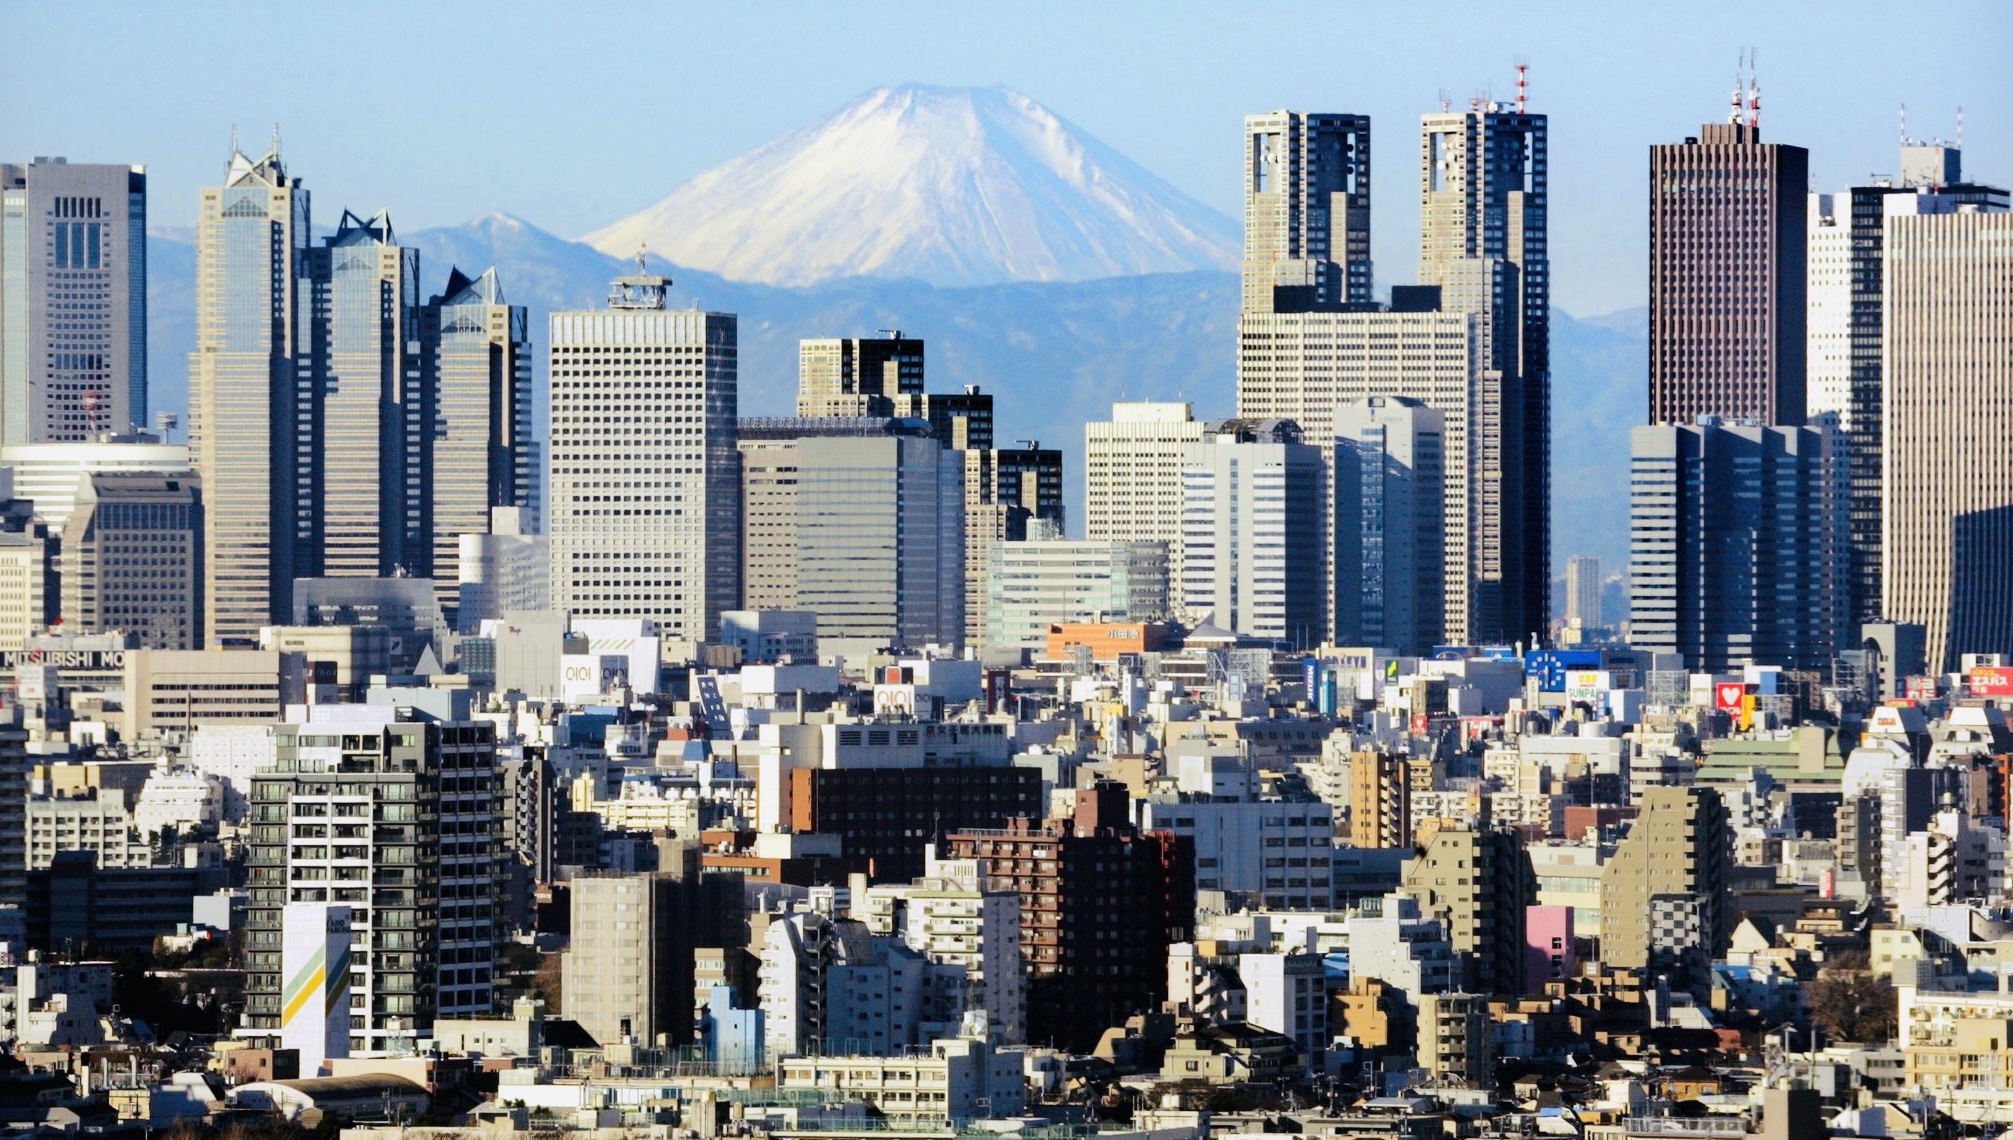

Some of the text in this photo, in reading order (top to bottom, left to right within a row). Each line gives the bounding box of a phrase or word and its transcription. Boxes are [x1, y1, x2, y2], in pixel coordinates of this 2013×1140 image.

[4, 651, 93, 666] MITSUBISHI
[1972, 673, 2009, 687] エスパス
